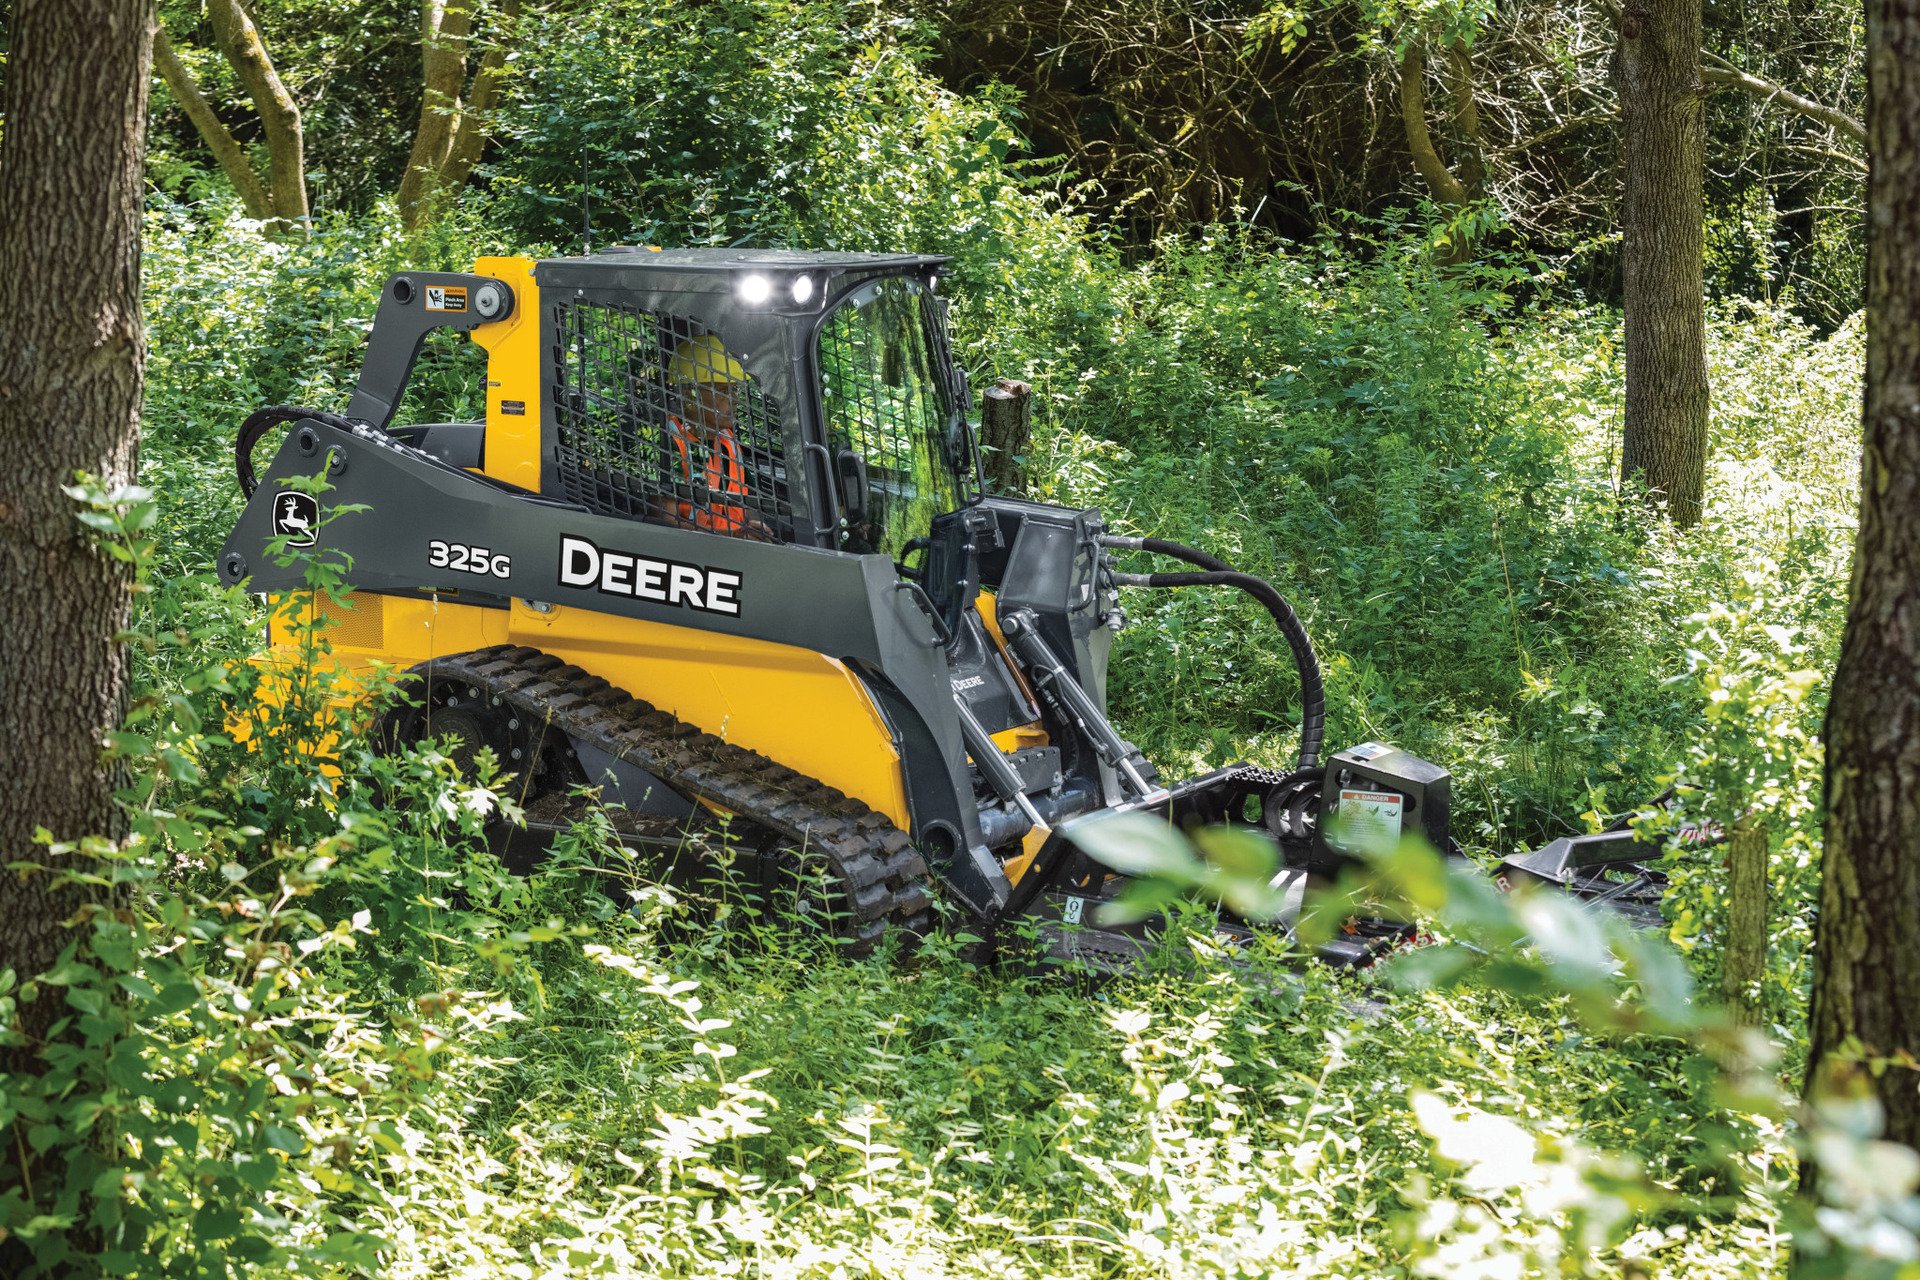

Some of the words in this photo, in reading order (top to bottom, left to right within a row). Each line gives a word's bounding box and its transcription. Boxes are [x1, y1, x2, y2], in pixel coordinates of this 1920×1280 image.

[429, 541, 511, 579] 325G
[561, 537, 741, 615] DEERE
[953, 676, 985, 690] DEERE
